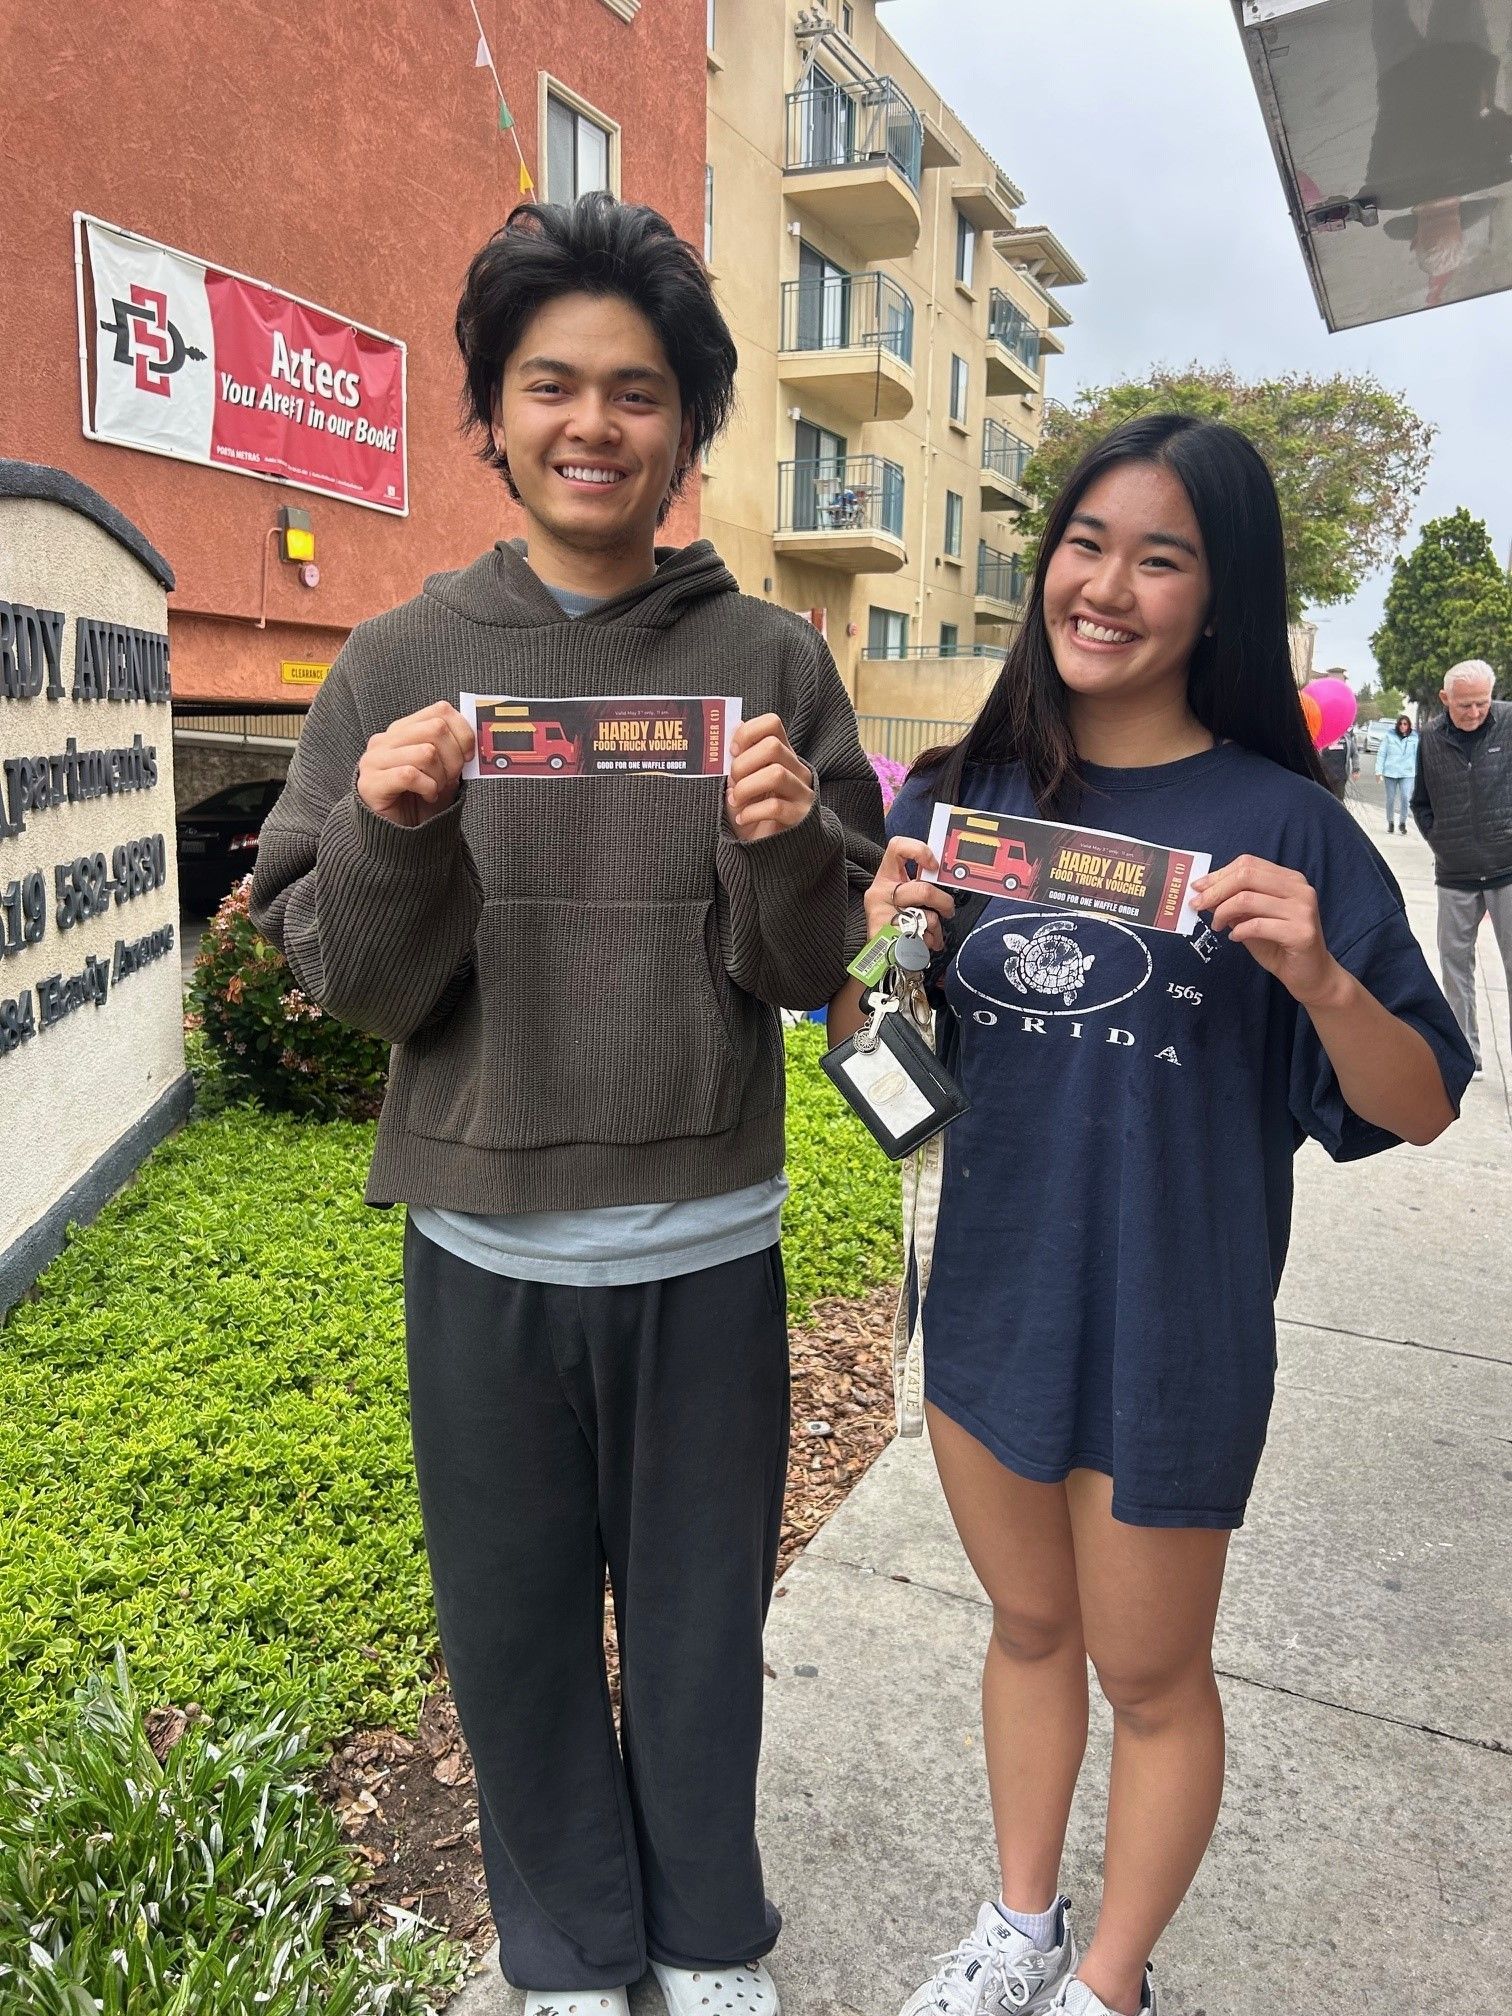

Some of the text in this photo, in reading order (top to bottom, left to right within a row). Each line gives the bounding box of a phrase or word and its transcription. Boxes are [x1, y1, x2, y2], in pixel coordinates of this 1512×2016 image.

[271, 330, 360, 408] Aztecs
[221, 372, 256, 408] You
[307, 400, 325, 430] in
[327, 413, 354, 439] our
[355, 416, 398, 453] Book!
[72, 617, 170, 703] AVENUE
[593, 739, 688, 751] FOOD TRUCK VOUCHER
[599, 720, 683, 740] HARDY AVE
[709, 724, 720, 763] VOUCHER
[597, 761, 687, 770] GOOD FOR ONE WAFFLE ORDER
[0, 734, 157, 838] partments
[1050, 867, 1147, 898] FOOD TRUCK VOUCHER
[1058, 850, 1146, 885] HARDY AVE
[0, 833, 166, 956] 19 582-9830
[1048, 890, 1140, 917] GOOD FOR ONE WAFFLE ORDER
[1163, 877, 1183, 917] VOUCHER
[112, 924, 174, 986] Avenue
[1166, 981, 1203, 1006] 1565
